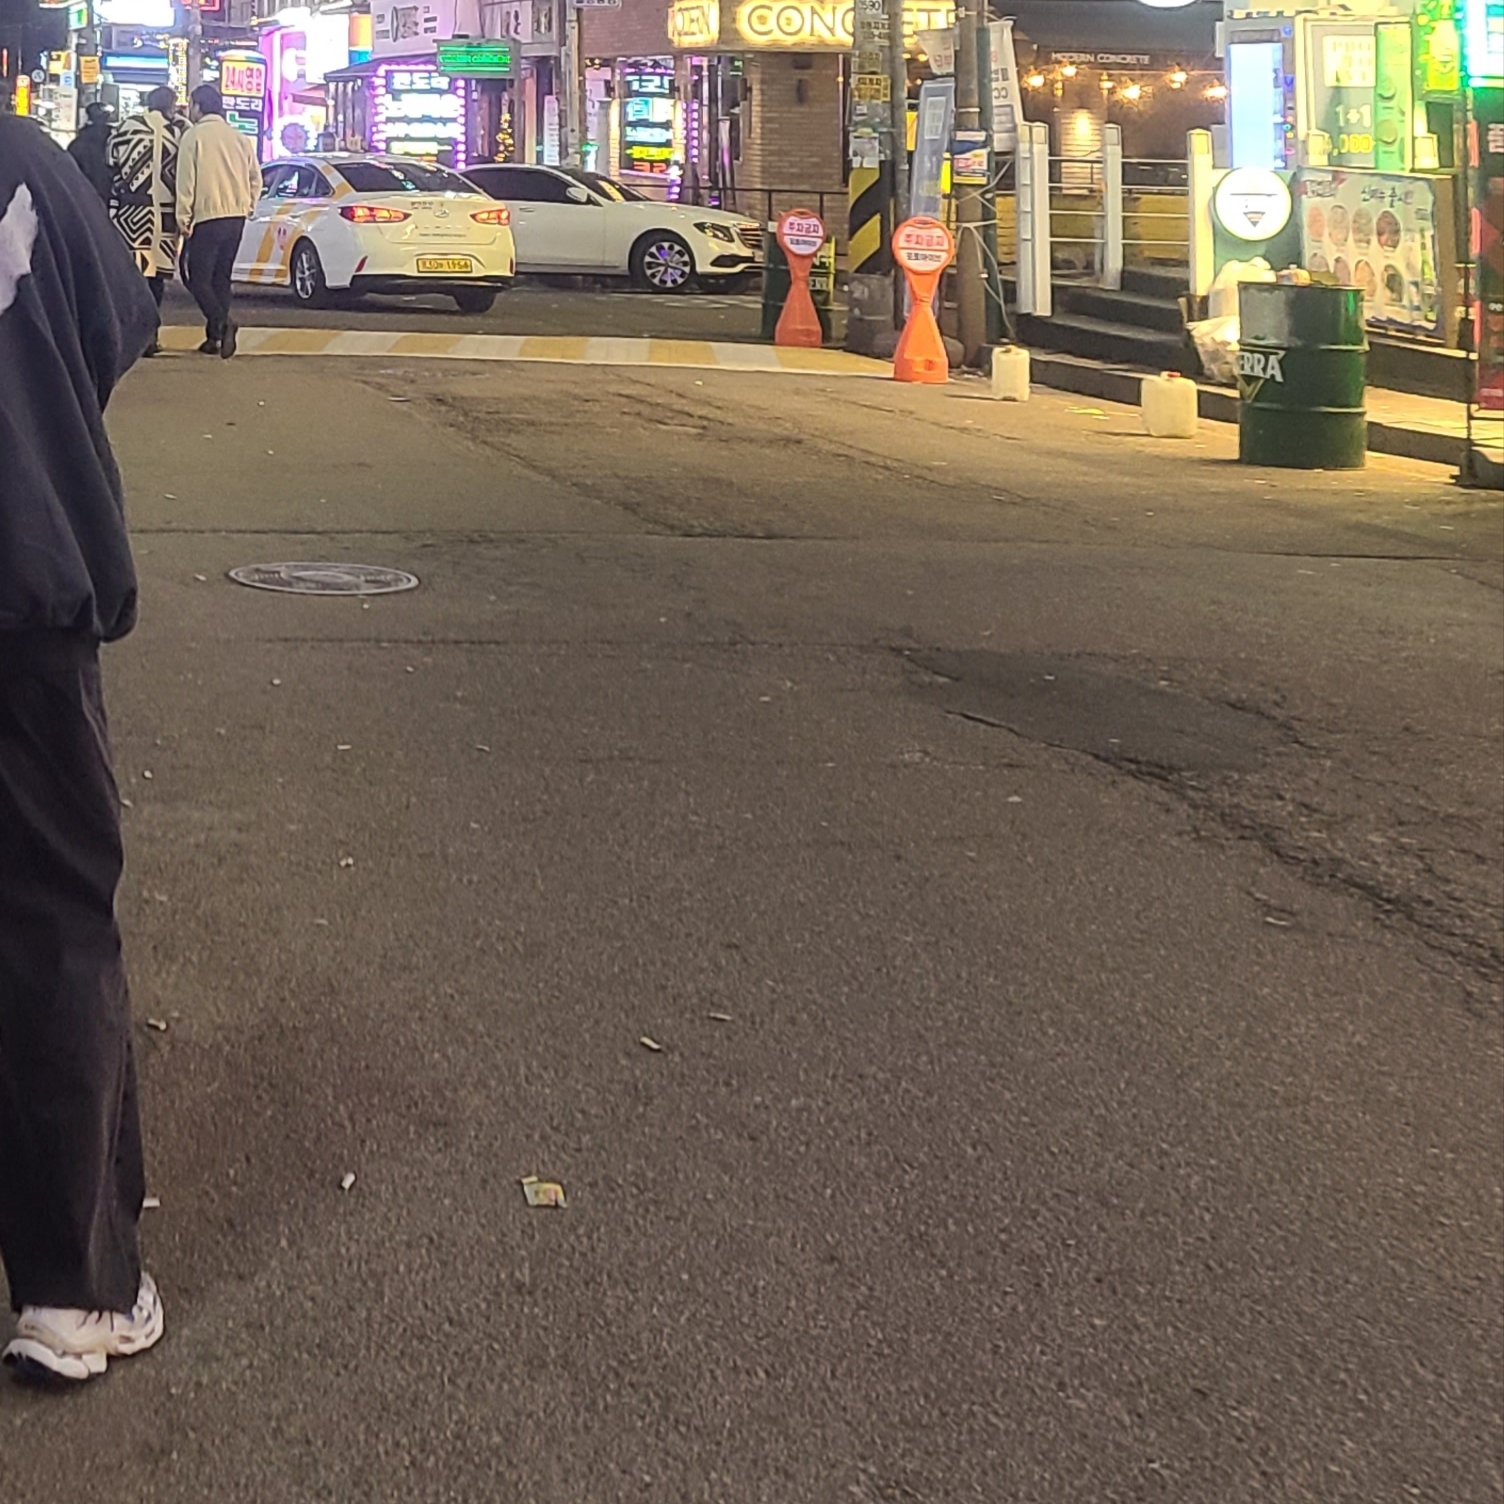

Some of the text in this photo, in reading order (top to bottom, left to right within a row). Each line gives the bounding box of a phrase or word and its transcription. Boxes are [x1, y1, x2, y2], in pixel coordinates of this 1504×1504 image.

[1051, 51, 1151, 65] MODERN CONCRETE
[1335, 104, 1373, 128] 1+1
[1326, 133, 1373, 156] ,000
[788, 221, 820, 235] 주차금지
[904, 233, 945, 248] 주차금지
